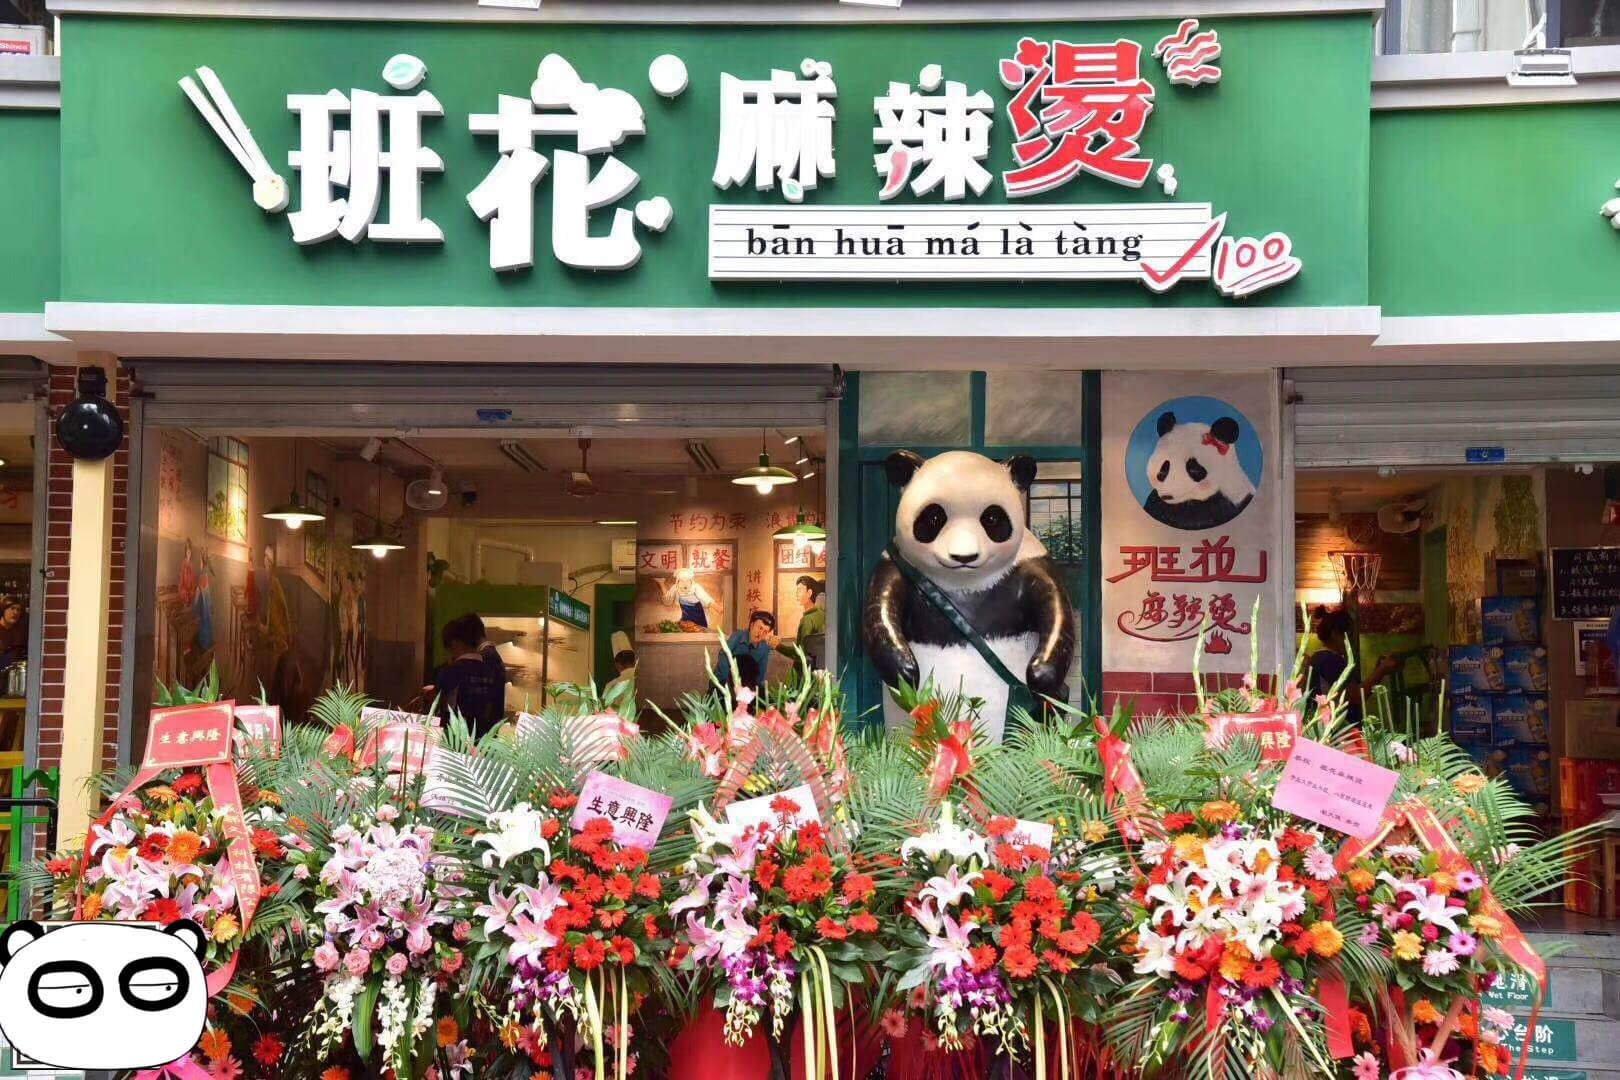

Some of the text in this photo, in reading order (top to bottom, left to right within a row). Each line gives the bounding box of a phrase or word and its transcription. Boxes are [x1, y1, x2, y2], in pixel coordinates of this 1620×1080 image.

[287, 54, 648, 271] 班花
[745, 220, 1144, 261] bān huā má là tàng
[1217, 235, 1285, 281] 100
[669, 512, 747, 533] 节约为荣
[1507, 991, 1529, 1000] Floor
[1526, 1044, 1555, 1055] Step
